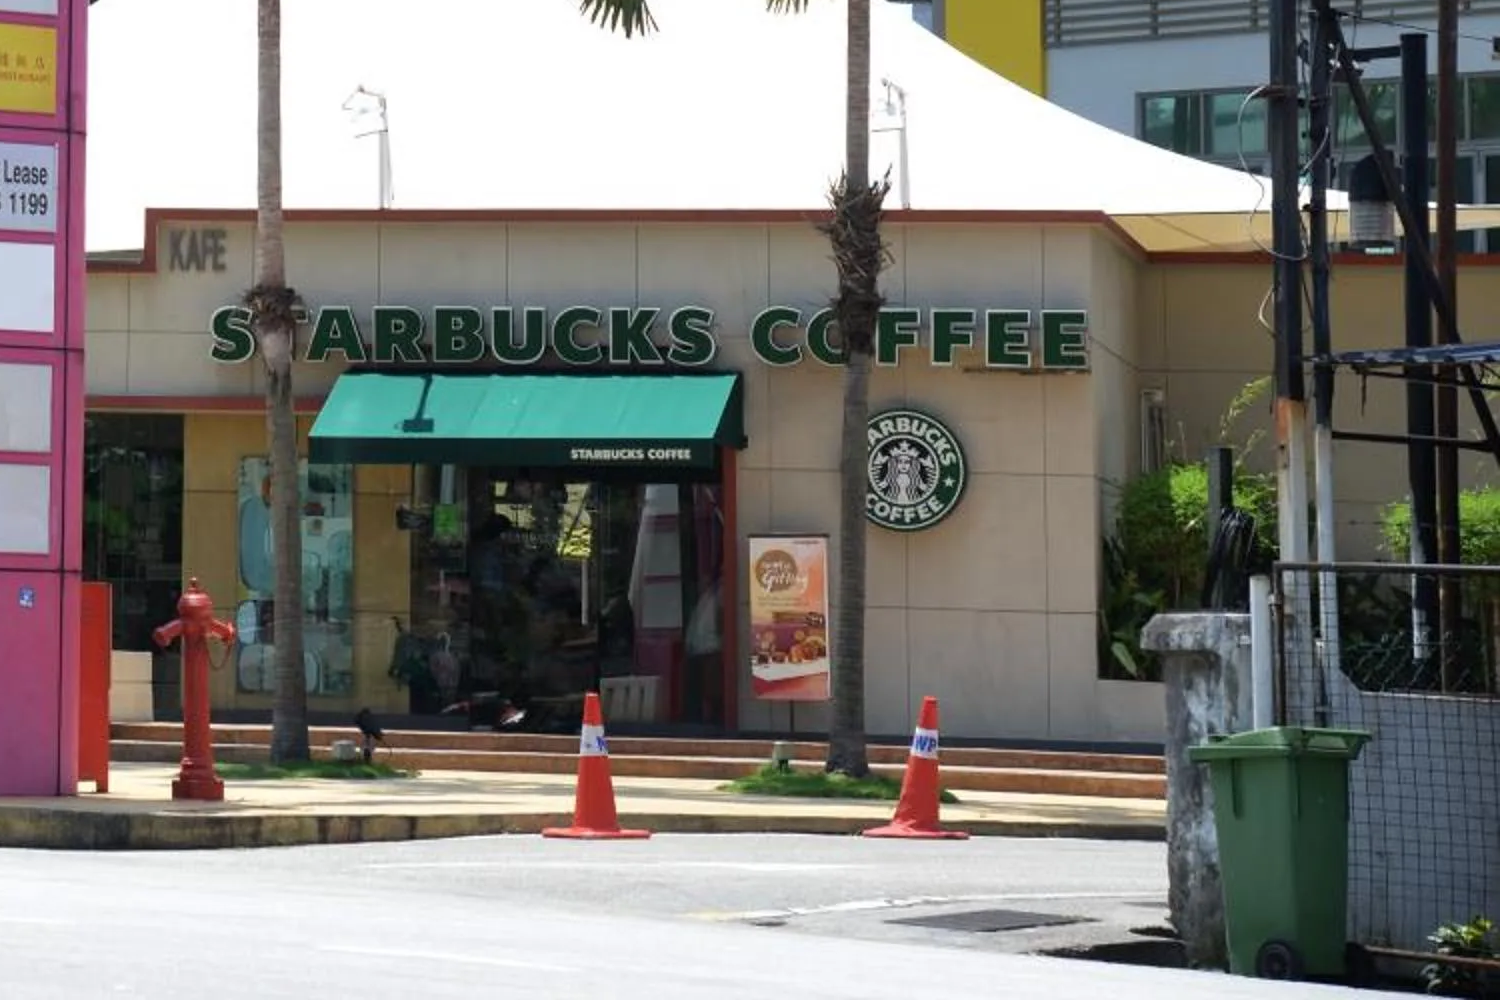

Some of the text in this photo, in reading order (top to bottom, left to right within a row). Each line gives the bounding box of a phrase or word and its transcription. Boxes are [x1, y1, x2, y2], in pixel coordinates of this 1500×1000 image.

[3, 159, 48, 185] Lease
[9, 191, 48, 216] 1199
[168, 227, 227, 272] KAFE
[209, 304, 717, 366] SARBUCKS
[571, 448, 691, 460] STARBUCKS COFFEE
[867, 417, 957, 466] ARBUCKS
[866, 493, 945, 523] COFFEE
